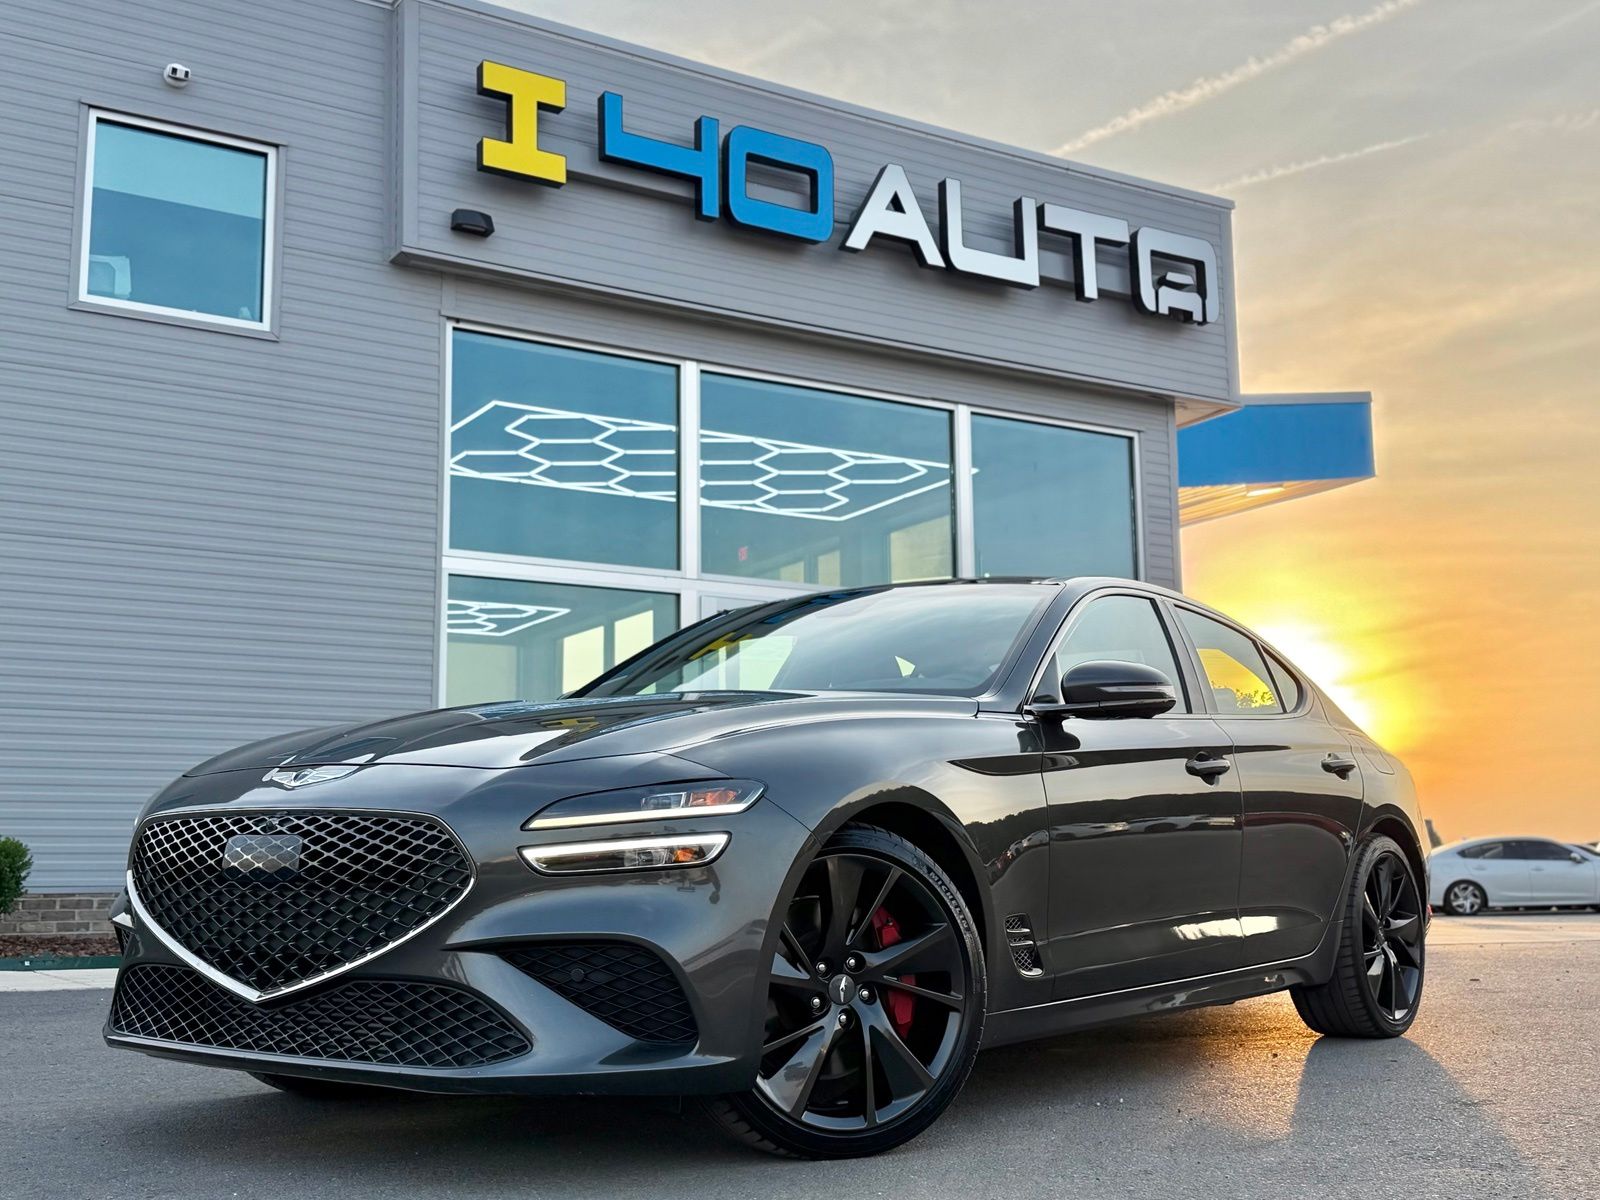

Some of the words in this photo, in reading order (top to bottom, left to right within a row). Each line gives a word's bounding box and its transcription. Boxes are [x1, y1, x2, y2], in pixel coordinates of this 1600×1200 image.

[477, 60, 567, 188] I
[598, 91, 834, 243] 40
[840, 163, 1220, 325] AUTO
[928, 871, 970, 930] MICHELIN
